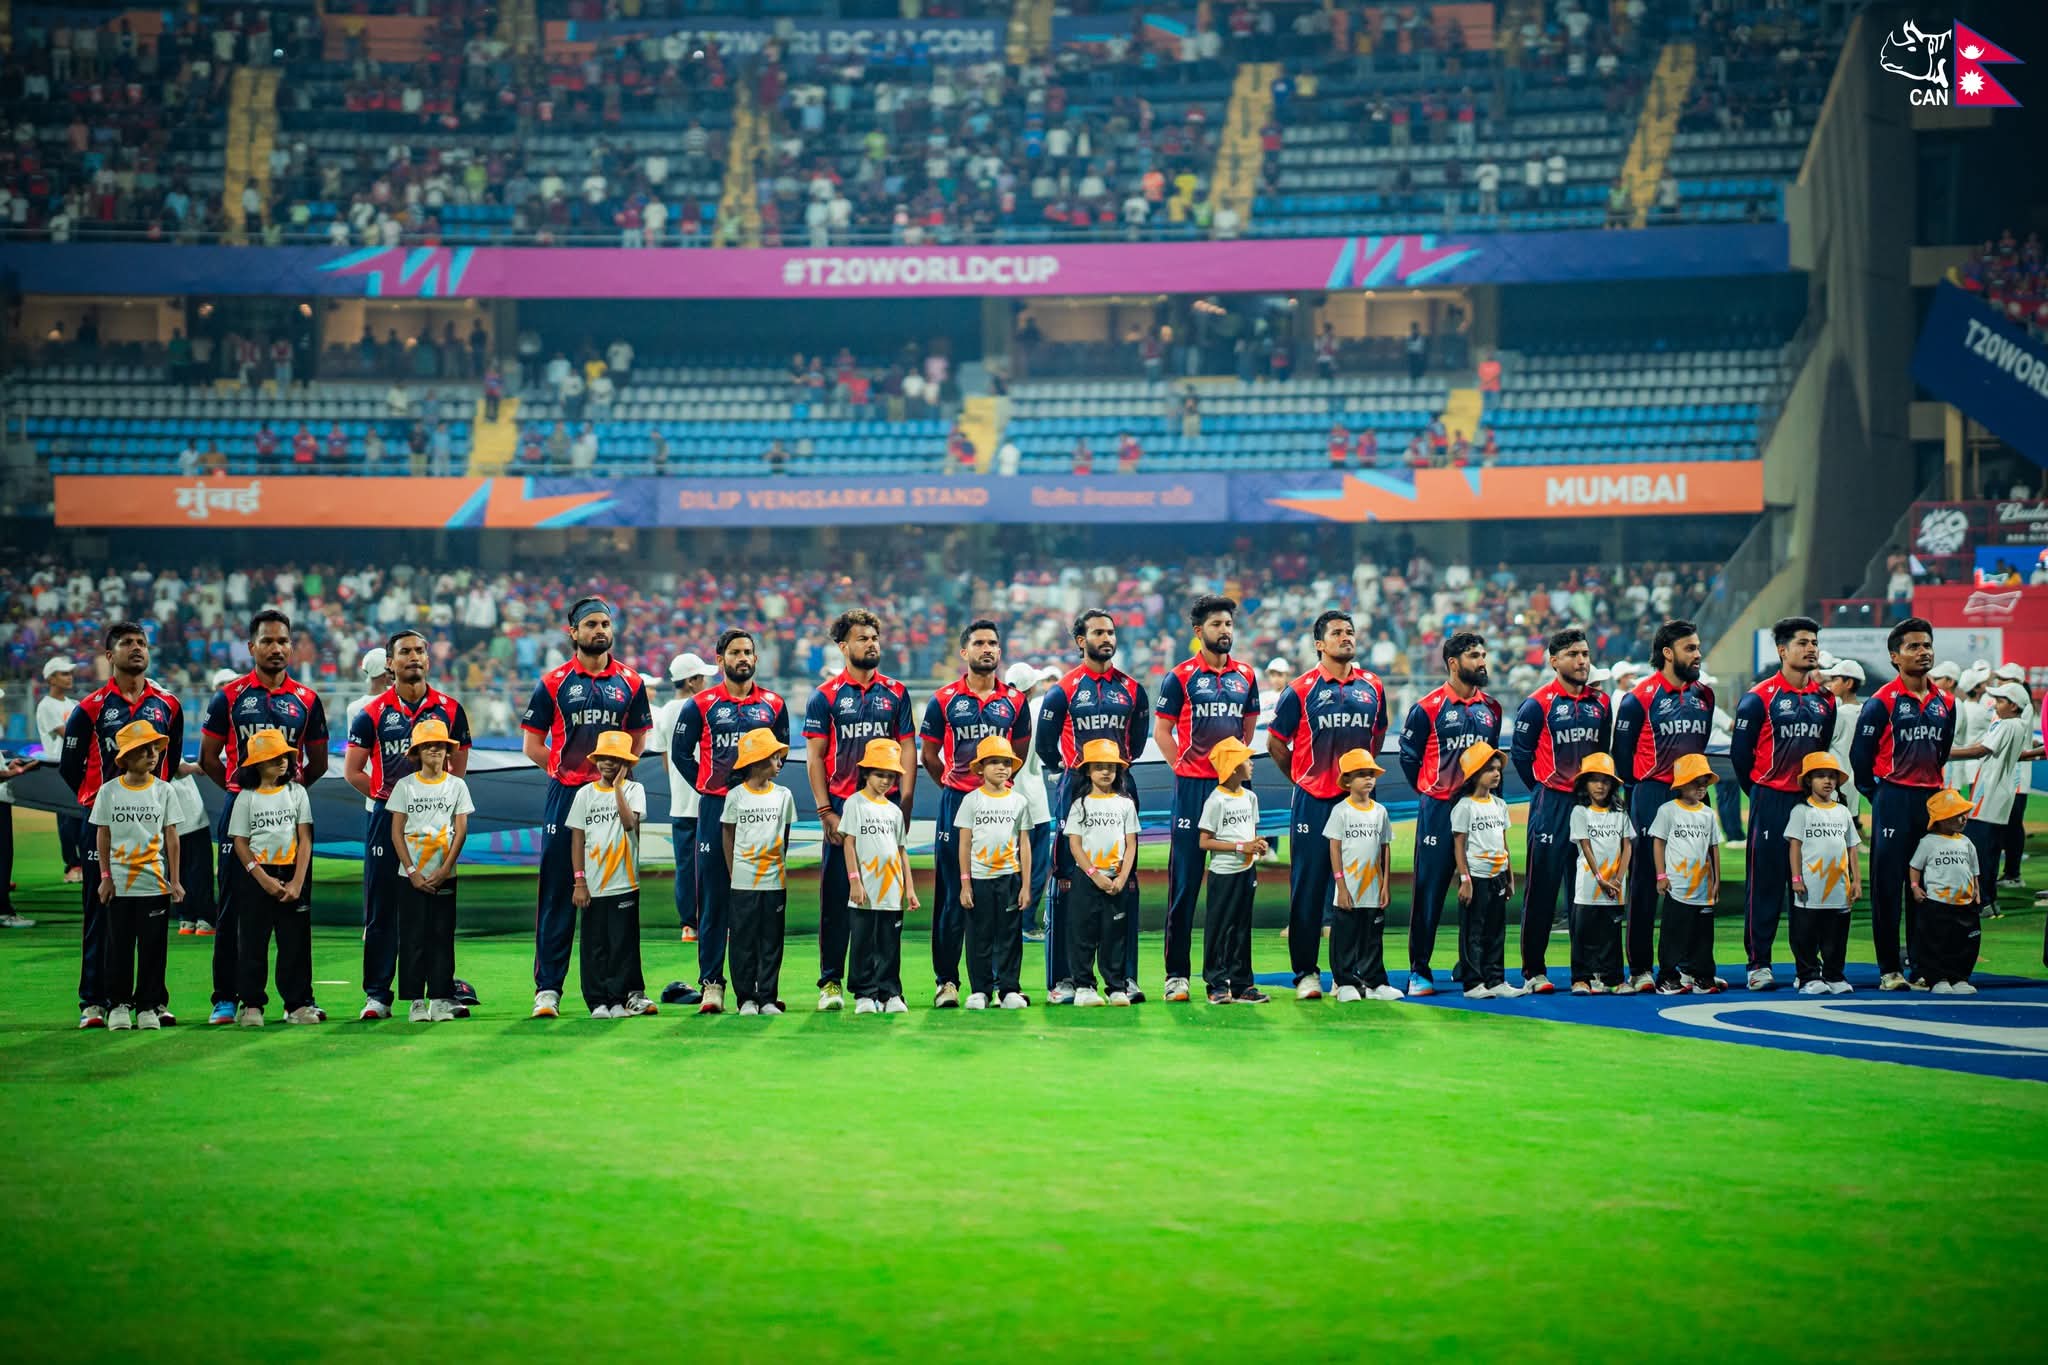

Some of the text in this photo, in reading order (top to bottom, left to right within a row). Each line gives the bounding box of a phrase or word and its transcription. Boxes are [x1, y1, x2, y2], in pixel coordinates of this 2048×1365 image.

[783, 256, 1059, 285] #T20WORLDCUP
[1546, 473, 1687, 507] MUMBAI
[175, 481, 262, 519] मुंबई
[679, 487, 989, 510] DILIP VENGSARKAR STAND
[1196, 702, 1244, 718] NEPAL
[571, 709, 620, 728] NEPAL
[1077, 714, 1126, 730] NEPAL
[1318, 713, 1371, 730] NEPAL
[841, 721, 890, 739] NEPAL
[1659, 719, 1707, 737] NEPAL
[1780, 722, 1824, 739] NEPAL
[1900, 725, 1944, 742] NEPAL
[716, 733, 747, 748] NEP
[1556, 727, 1600, 745] NEPAL
[408, 802, 452, 813] BONVOY
[590, 806, 618, 814] MARRI
[585, 812, 621, 826] BONV
[976, 816, 1017, 826] BONVOY
[1178, 818, 1191, 829] 22
[1223, 815, 1251, 827] BONV
[546, 823, 557, 835] 15
[1297, 823, 1309, 834] 33
[1763, 829, 1769, 840] 1
[1882, 827, 1896, 838] 17
[938, 831, 950, 842] 75
[1423, 836, 1437, 846] 45
[1540, 833, 1553, 843] 21
[222, 844, 233, 854] 27
[371, 846, 384, 857] 10
[700, 843, 711, 853] 24
[87, 850, 99, 861] 25
[1935, 856, 1969, 866] BONV
